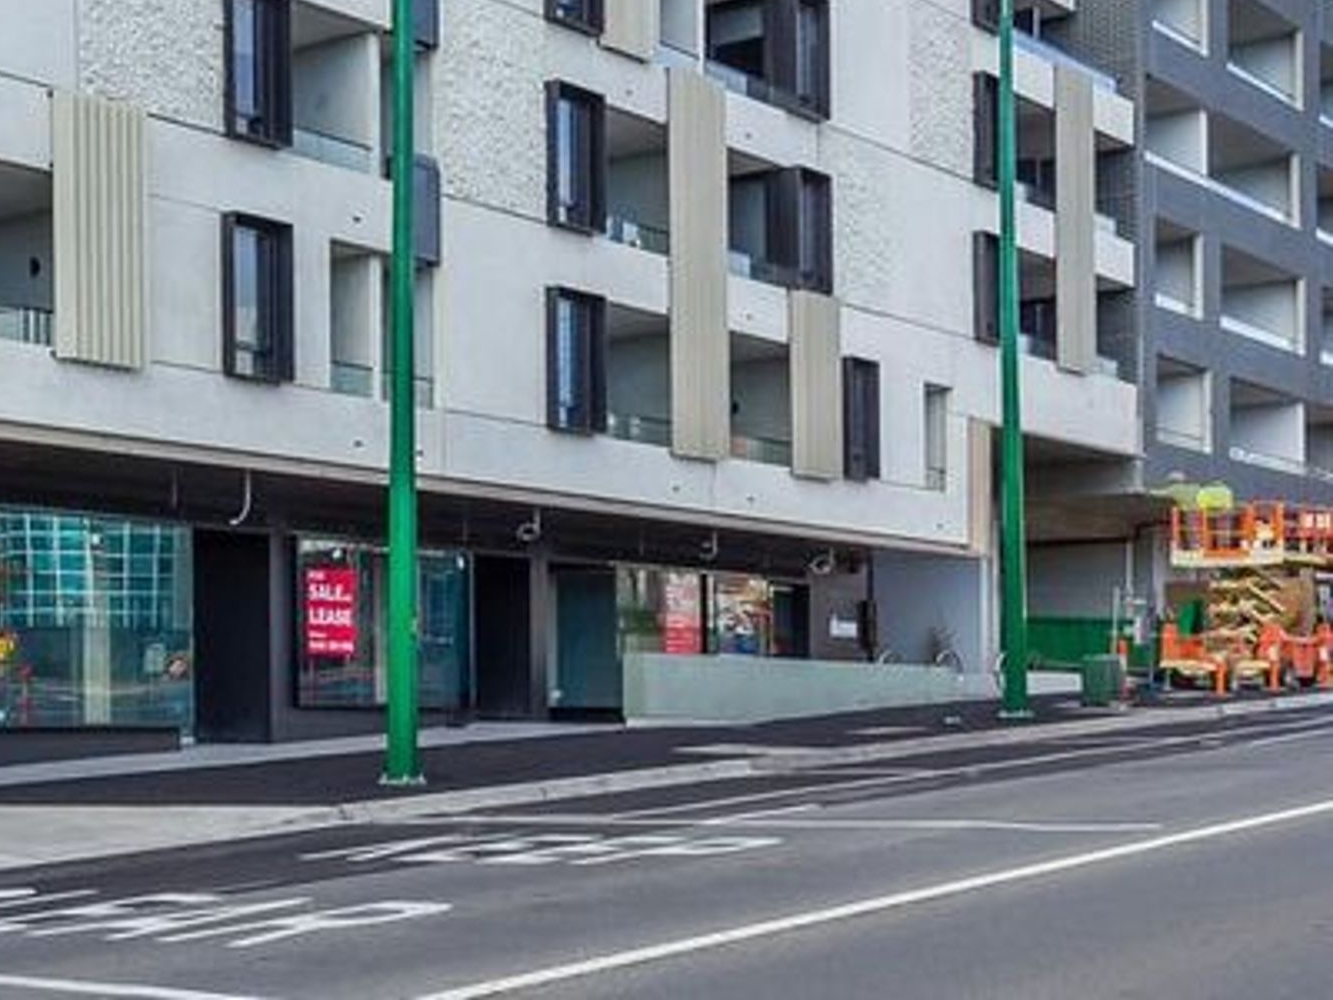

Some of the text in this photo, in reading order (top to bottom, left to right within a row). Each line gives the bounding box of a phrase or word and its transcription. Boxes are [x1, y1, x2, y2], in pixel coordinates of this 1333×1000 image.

[308, 583, 344, 601] SALE
[308, 608, 352, 625] LEASE
[299, 832, 785, 866] KEEP
